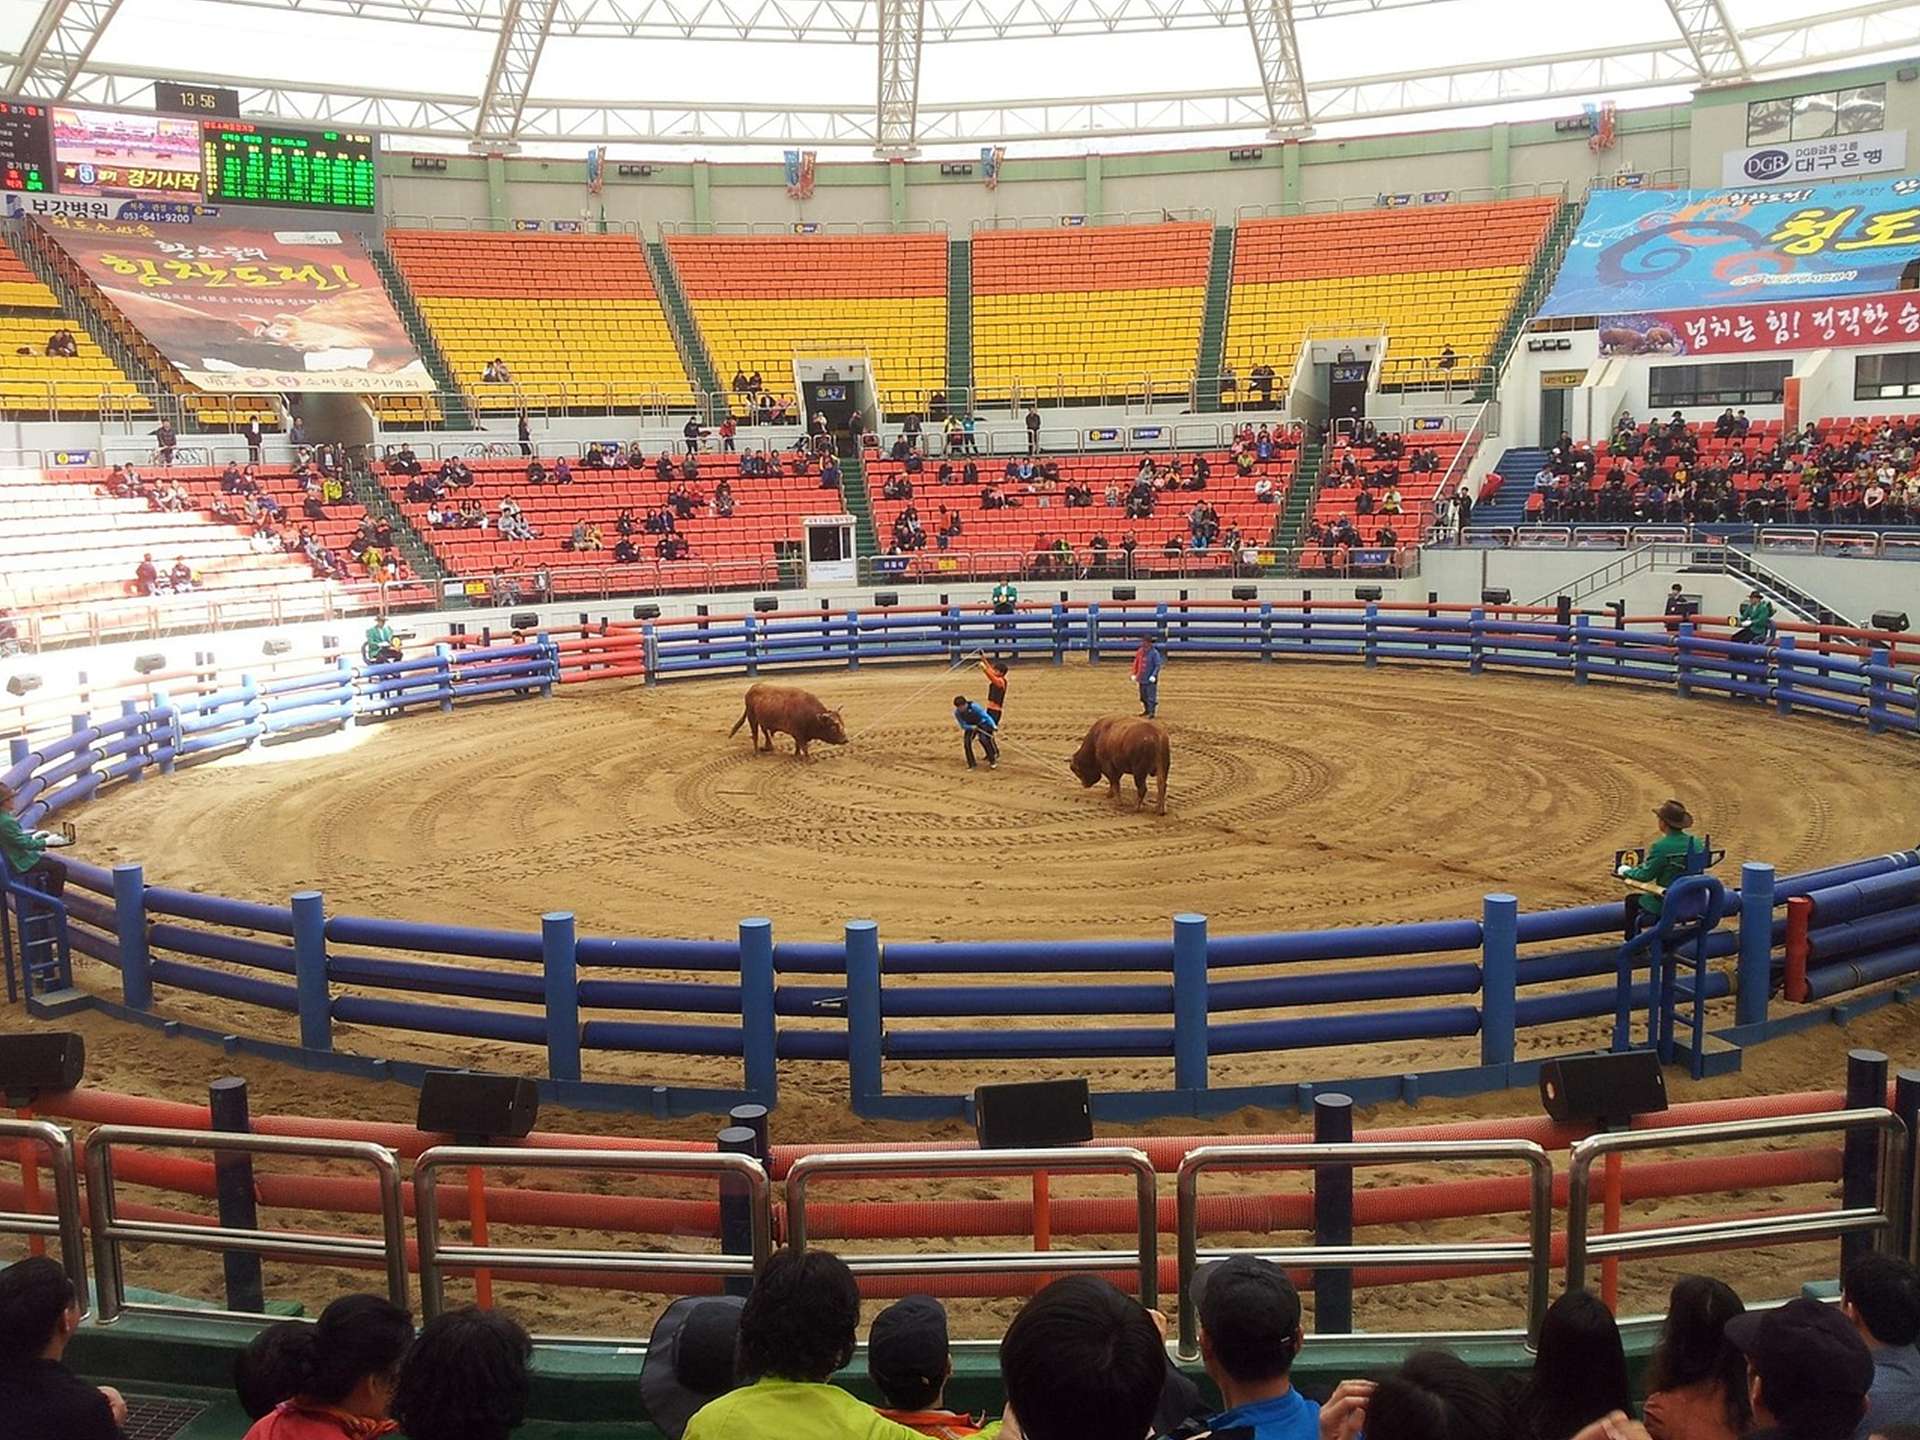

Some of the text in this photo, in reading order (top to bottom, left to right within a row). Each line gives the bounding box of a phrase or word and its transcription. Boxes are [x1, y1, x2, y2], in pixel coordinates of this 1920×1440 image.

[179, 92, 216, 108] 13:56
[1795, 141, 1858, 158] DGB금융그룹
[1747, 156, 1786, 174] DGB
[1795, 148, 1882, 173] 대구은행
[79, 163, 96, 184] 5
[127, 168, 199, 191] 경기시작
[122, 211, 190, 223] 053-641-9200
[1684, 315, 1756, 350] 넘치는
[1766, 309, 1801, 345] 힘!
[1811, 303, 1889, 341] 정직한
